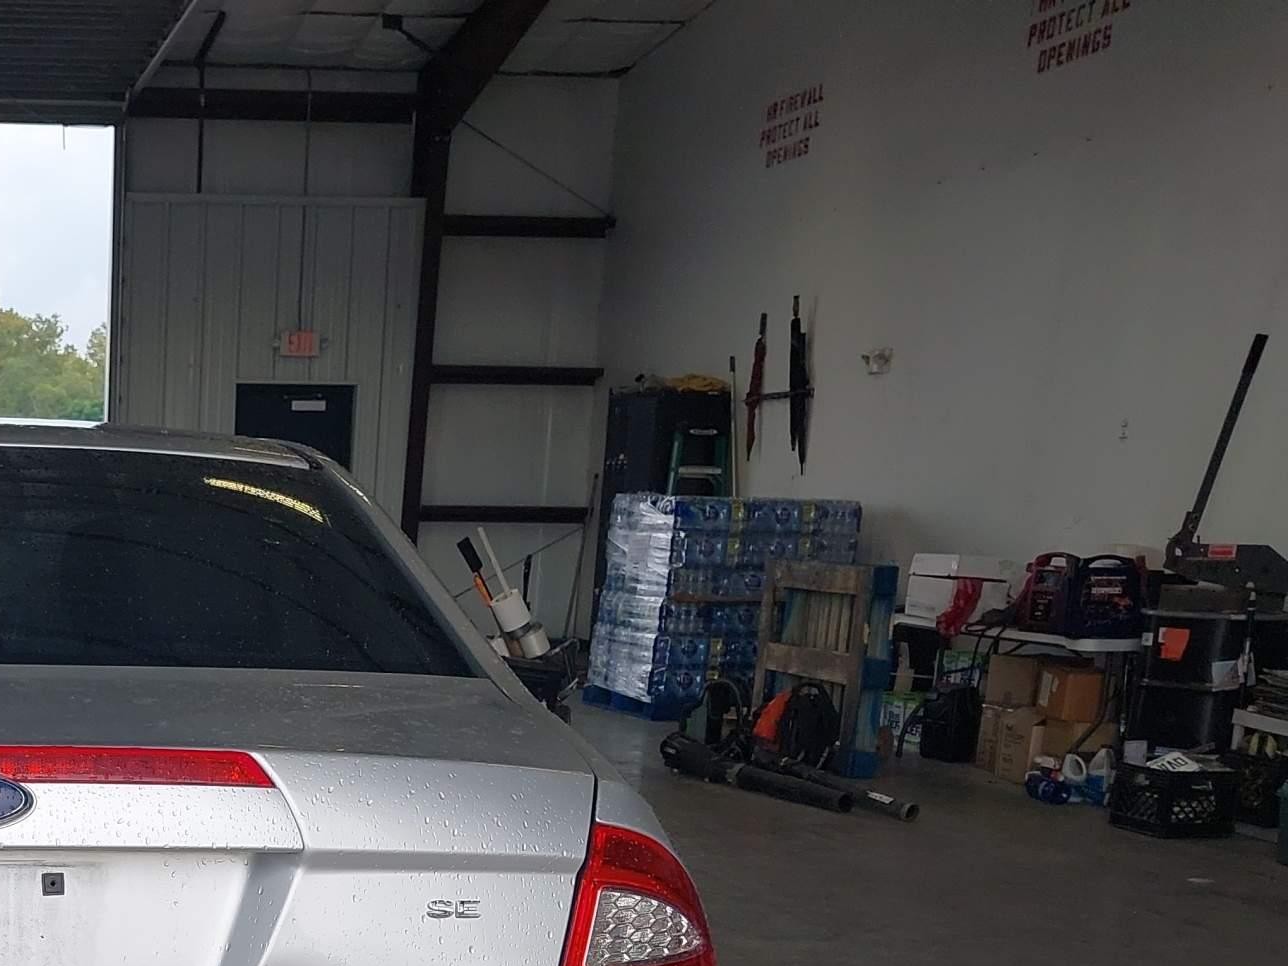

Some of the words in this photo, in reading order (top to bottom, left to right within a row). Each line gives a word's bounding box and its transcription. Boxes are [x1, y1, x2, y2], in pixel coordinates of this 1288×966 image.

[1027, 0, 1096, 47] PROTECT
[1037, 23, 1113, 74] OPENINGS
[760, 116, 801, 148] PROTECT
[765, 136, 810, 168] OPENINGS
[426, 899, 482, 919] SE
